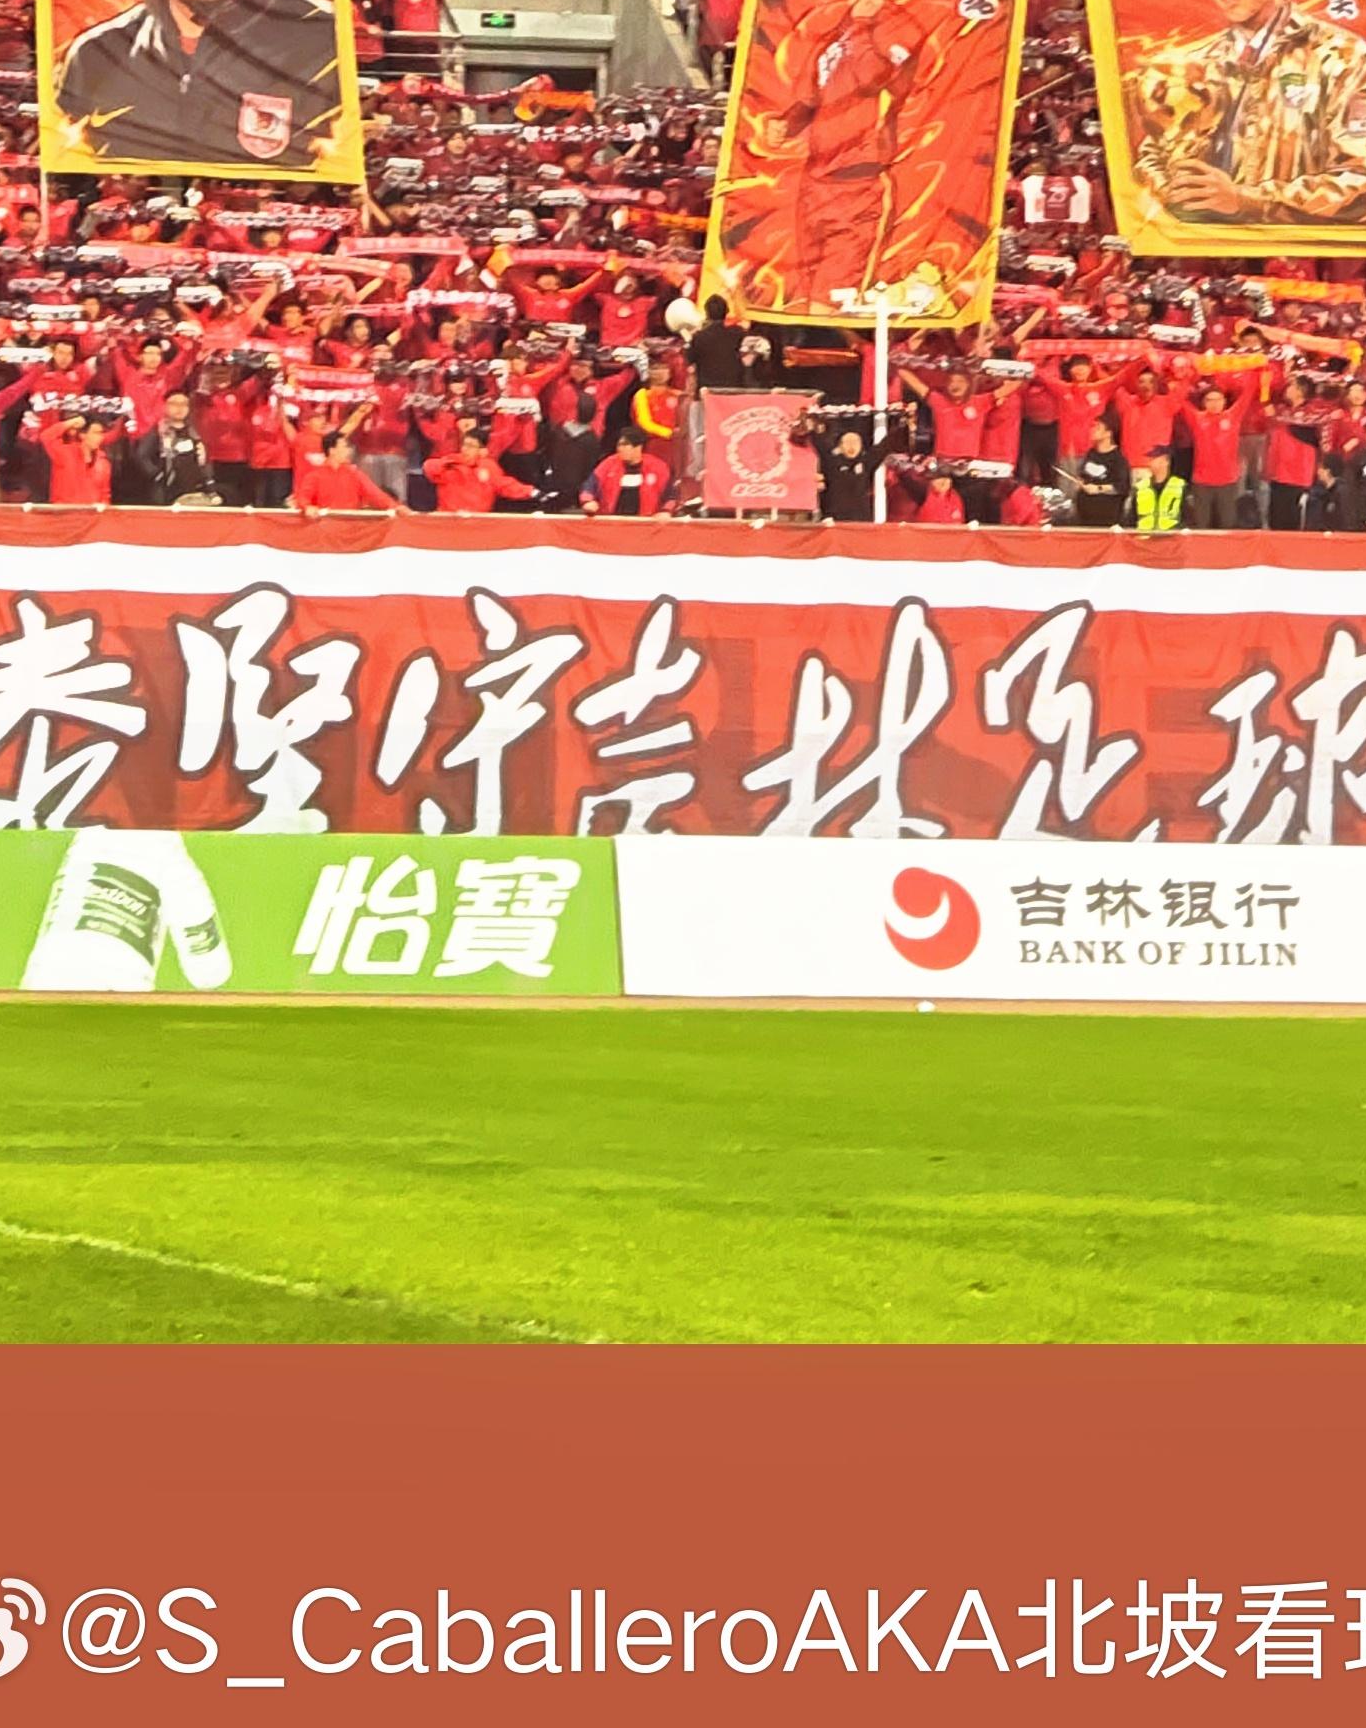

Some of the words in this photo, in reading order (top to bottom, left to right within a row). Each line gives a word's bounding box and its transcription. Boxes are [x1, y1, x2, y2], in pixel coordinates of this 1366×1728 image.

[1009, 875, 1302, 932] 吉林银行
[1019, 940, 1126, 966] BANK
[1137, 941, 1186, 966] OF
[1202, 941, 1299, 968] JILIN
